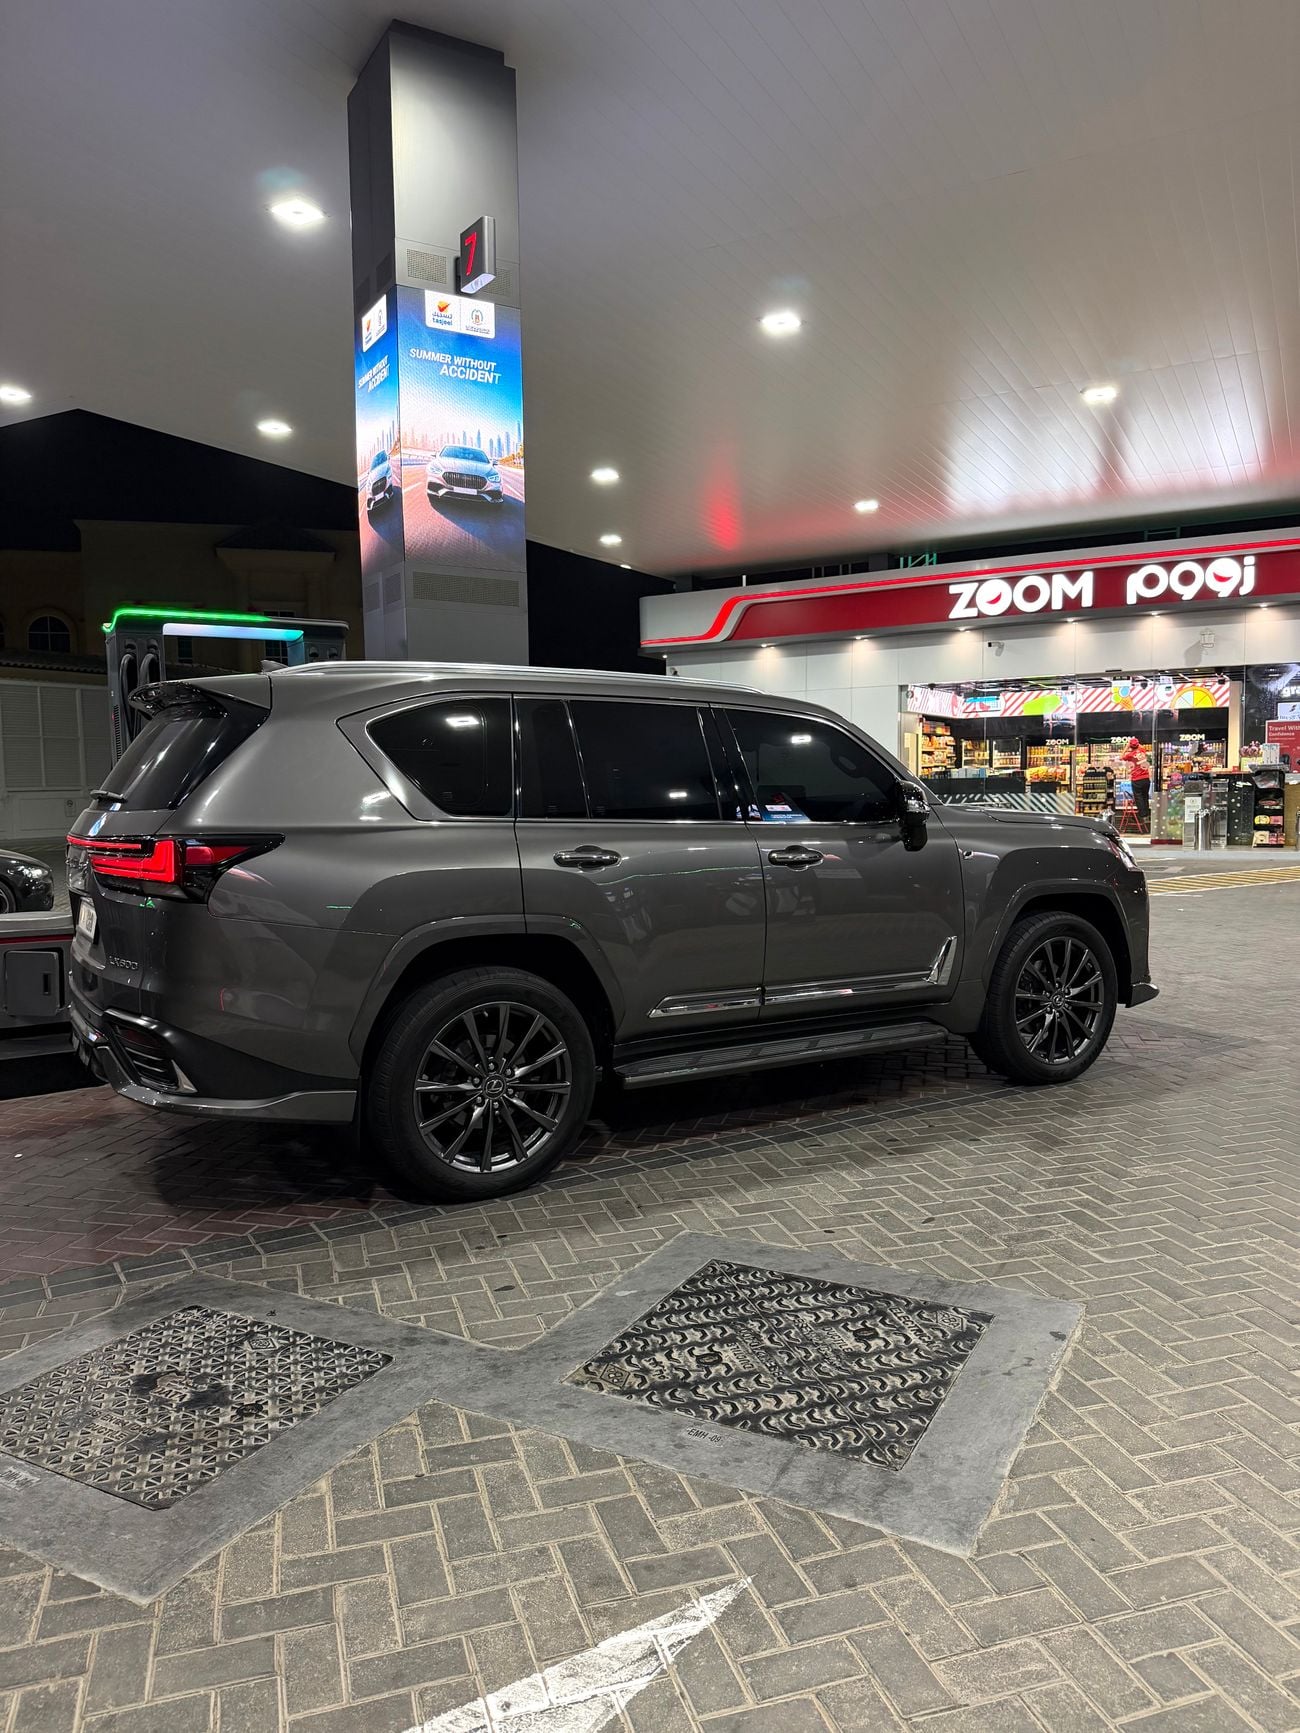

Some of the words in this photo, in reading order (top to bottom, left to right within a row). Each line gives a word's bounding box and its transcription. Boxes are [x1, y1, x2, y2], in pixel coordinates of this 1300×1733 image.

[464, 231, 477, 276] 7
[432, 318, 453, 327] tasjeel
[409, 348, 452, 364] SUMMER
[453, 355, 497, 371] WITHOUT
[439, 364, 502, 385] ACCIDENT
[948, 571, 1094, 620] ZOOM
[1045, 738, 1069, 746] ZOOM
[1179, 733, 1206, 741] ZOOM
[84, 1422, 128, 1440] DUCTILE
